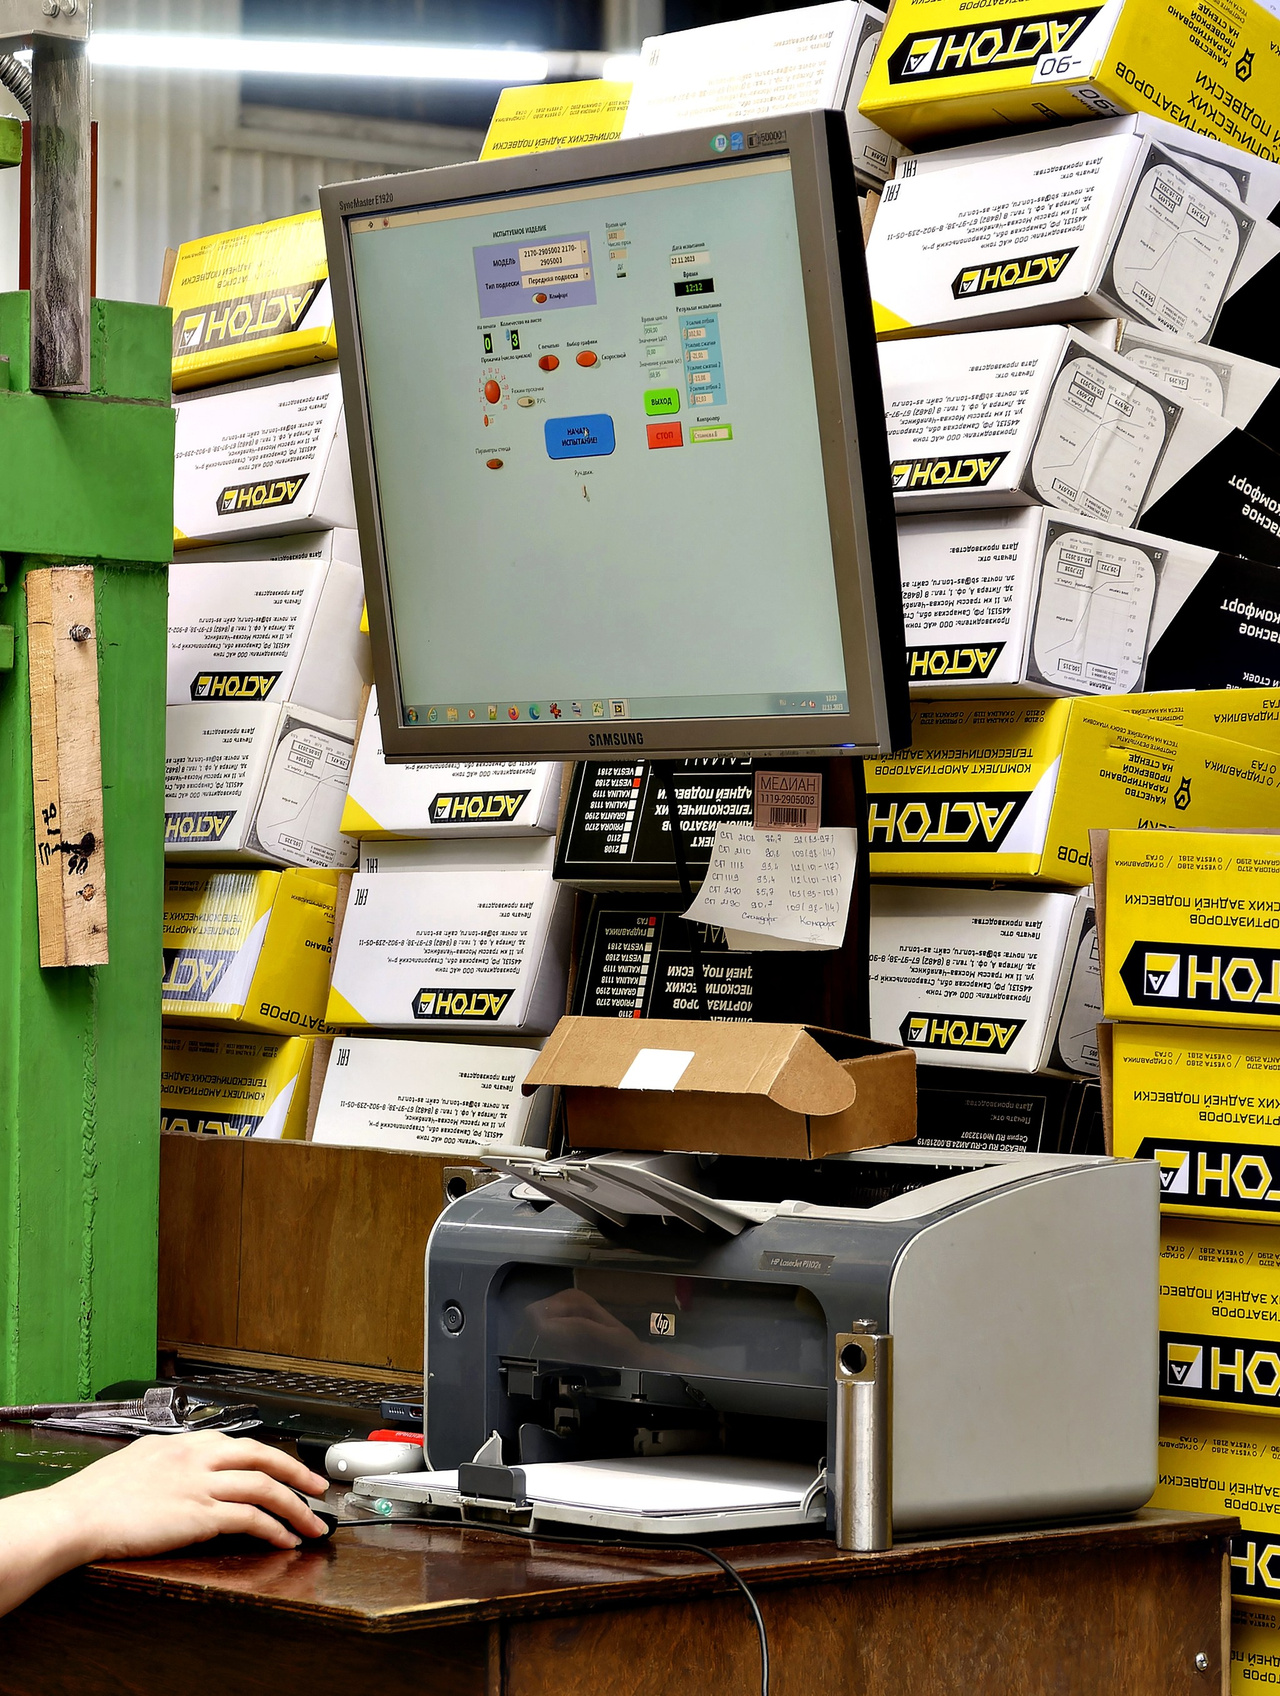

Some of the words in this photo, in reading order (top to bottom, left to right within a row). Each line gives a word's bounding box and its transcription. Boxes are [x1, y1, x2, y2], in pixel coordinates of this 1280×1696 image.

[1197, 3, 1227, 31] СТЕНДЕ
[1167, 5, 1232, 58] ГАРАНТИРОВАНО
[1189, 10, 1236, 48] ПРОВЕРКОЙ
[1228, 25, 1240, 39] НА
[936, 15, 1087, 71] АСТОН
[1189, 34, 1228, 68] КАЧЕСТВО
[1195, 70, 1272, 137] ПОДВЕСКИ
[492, 138, 534, 151] ПОДВЕСКИ
[535, 134, 568, 148] ЗАДНЕЙ
[492, 257, 516, 268] МОДЕЛЬ
[540, 256, 563, 267] 2905003
[980, 253, 1069, 291] АСТОН
[685, 282, 703, 293] 12:12
[204, 287, 314, 343] АСТОН
[512, 334, 518, 347] 3
[651, 397, 672, 406] ВЫХОД
[656, 431, 674, 440] СТОП
[911, 456, 1000, 485] АСТОН
[236, 478, 303, 509] АСТОН
[910, 648, 998, 674] АСТОН
[212, 675, 276, 696] АСТОН
[588, 732, 644, 747] SAMSUNG
[925, 748, 1034, 760] ТЕЛЕСКОПИЧЕСКИХ
[971, 763, 1032, 774] КОМПЛЕКТ
[1128, 754, 1161, 769] СТЕНДЕ
[1161, 763, 1174, 772] НА
[874, 764, 969, 776] АМОРТИЗАТОРОВ
[1122, 764, 1171, 783] ПРОВЕРКОЙ
[1099, 769, 1169, 794] ГАРАНТИРОВАНО
[1124, 787, 1167, 805] КАЧЕСТВО
[451, 794, 524, 818] АСТОН
[868, 802, 1016, 842] АСТОН
[1114, 860, 1158, 868] ГИДРАВЛИКА
[1124, 894, 1191, 907] ПОДВЕСКИ
[1194, 897, 1245, 911] ЗАДНЕЙ
[637, 917, 649, 925] ГАЗ
[623, 943, 644, 951] VESTA
[621, 954, 642, 962] VESTA
[617, 965, 641, 973] KALINA
[616, 976, 639, 984] KALINA
[596, 987, 610, 995] 2190
[435, 993, 507, 1016] АСТОН
[596, 998, 611, 1006] 2170
[929, 1019, 1017, 1048] АСТОН
[190, 1072, 268, 1089] ТЕЛЕСКОПИЧЕСКИХ
[222, 1088, 266, 1101] КОМПЛЕКТ
[1133, 1090, 1200, 1104] ПОДВЕСКИ
[1204, 1094, 1255, 1107] ЗАДНЕЙ
[1216, 1290, 1267, 1304] ЗАДНЕЙ
[1159, 1474, 1225, 1491] ПОДВЕСКИ
[1229, 1482, 1280, 1498] ЗАДНЕЙ
